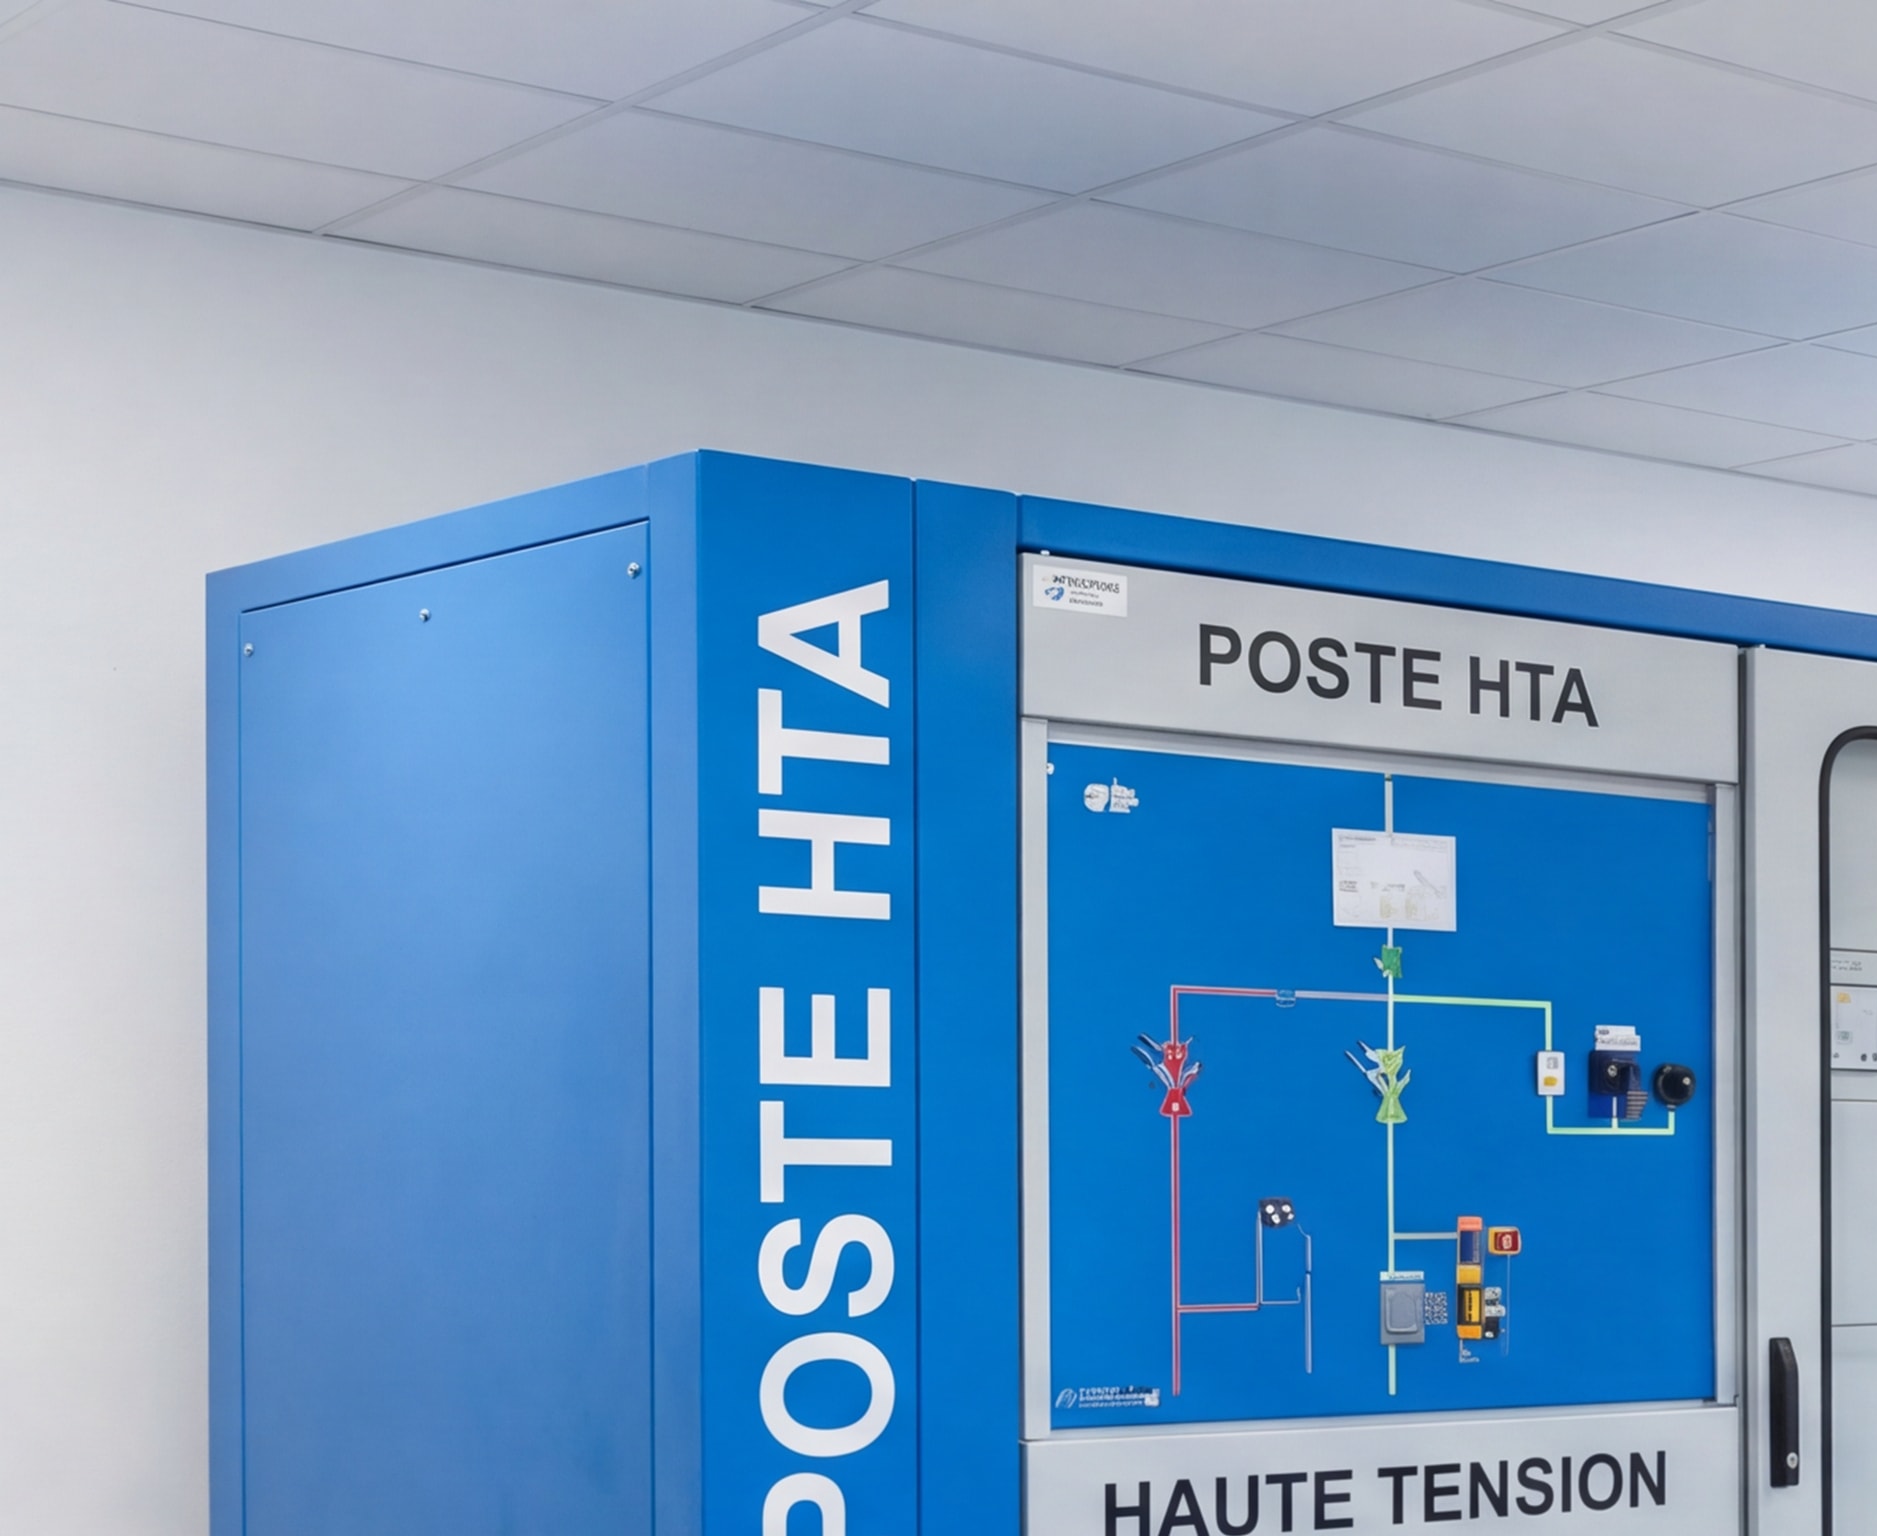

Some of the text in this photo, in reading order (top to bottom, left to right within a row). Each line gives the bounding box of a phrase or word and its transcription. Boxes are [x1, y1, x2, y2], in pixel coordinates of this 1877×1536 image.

[1198, 623, 1600, 728] POSTE HTA
[757, 579, 891, 920] HTA
[1377, 1450, 1667, 1525] TENSION
